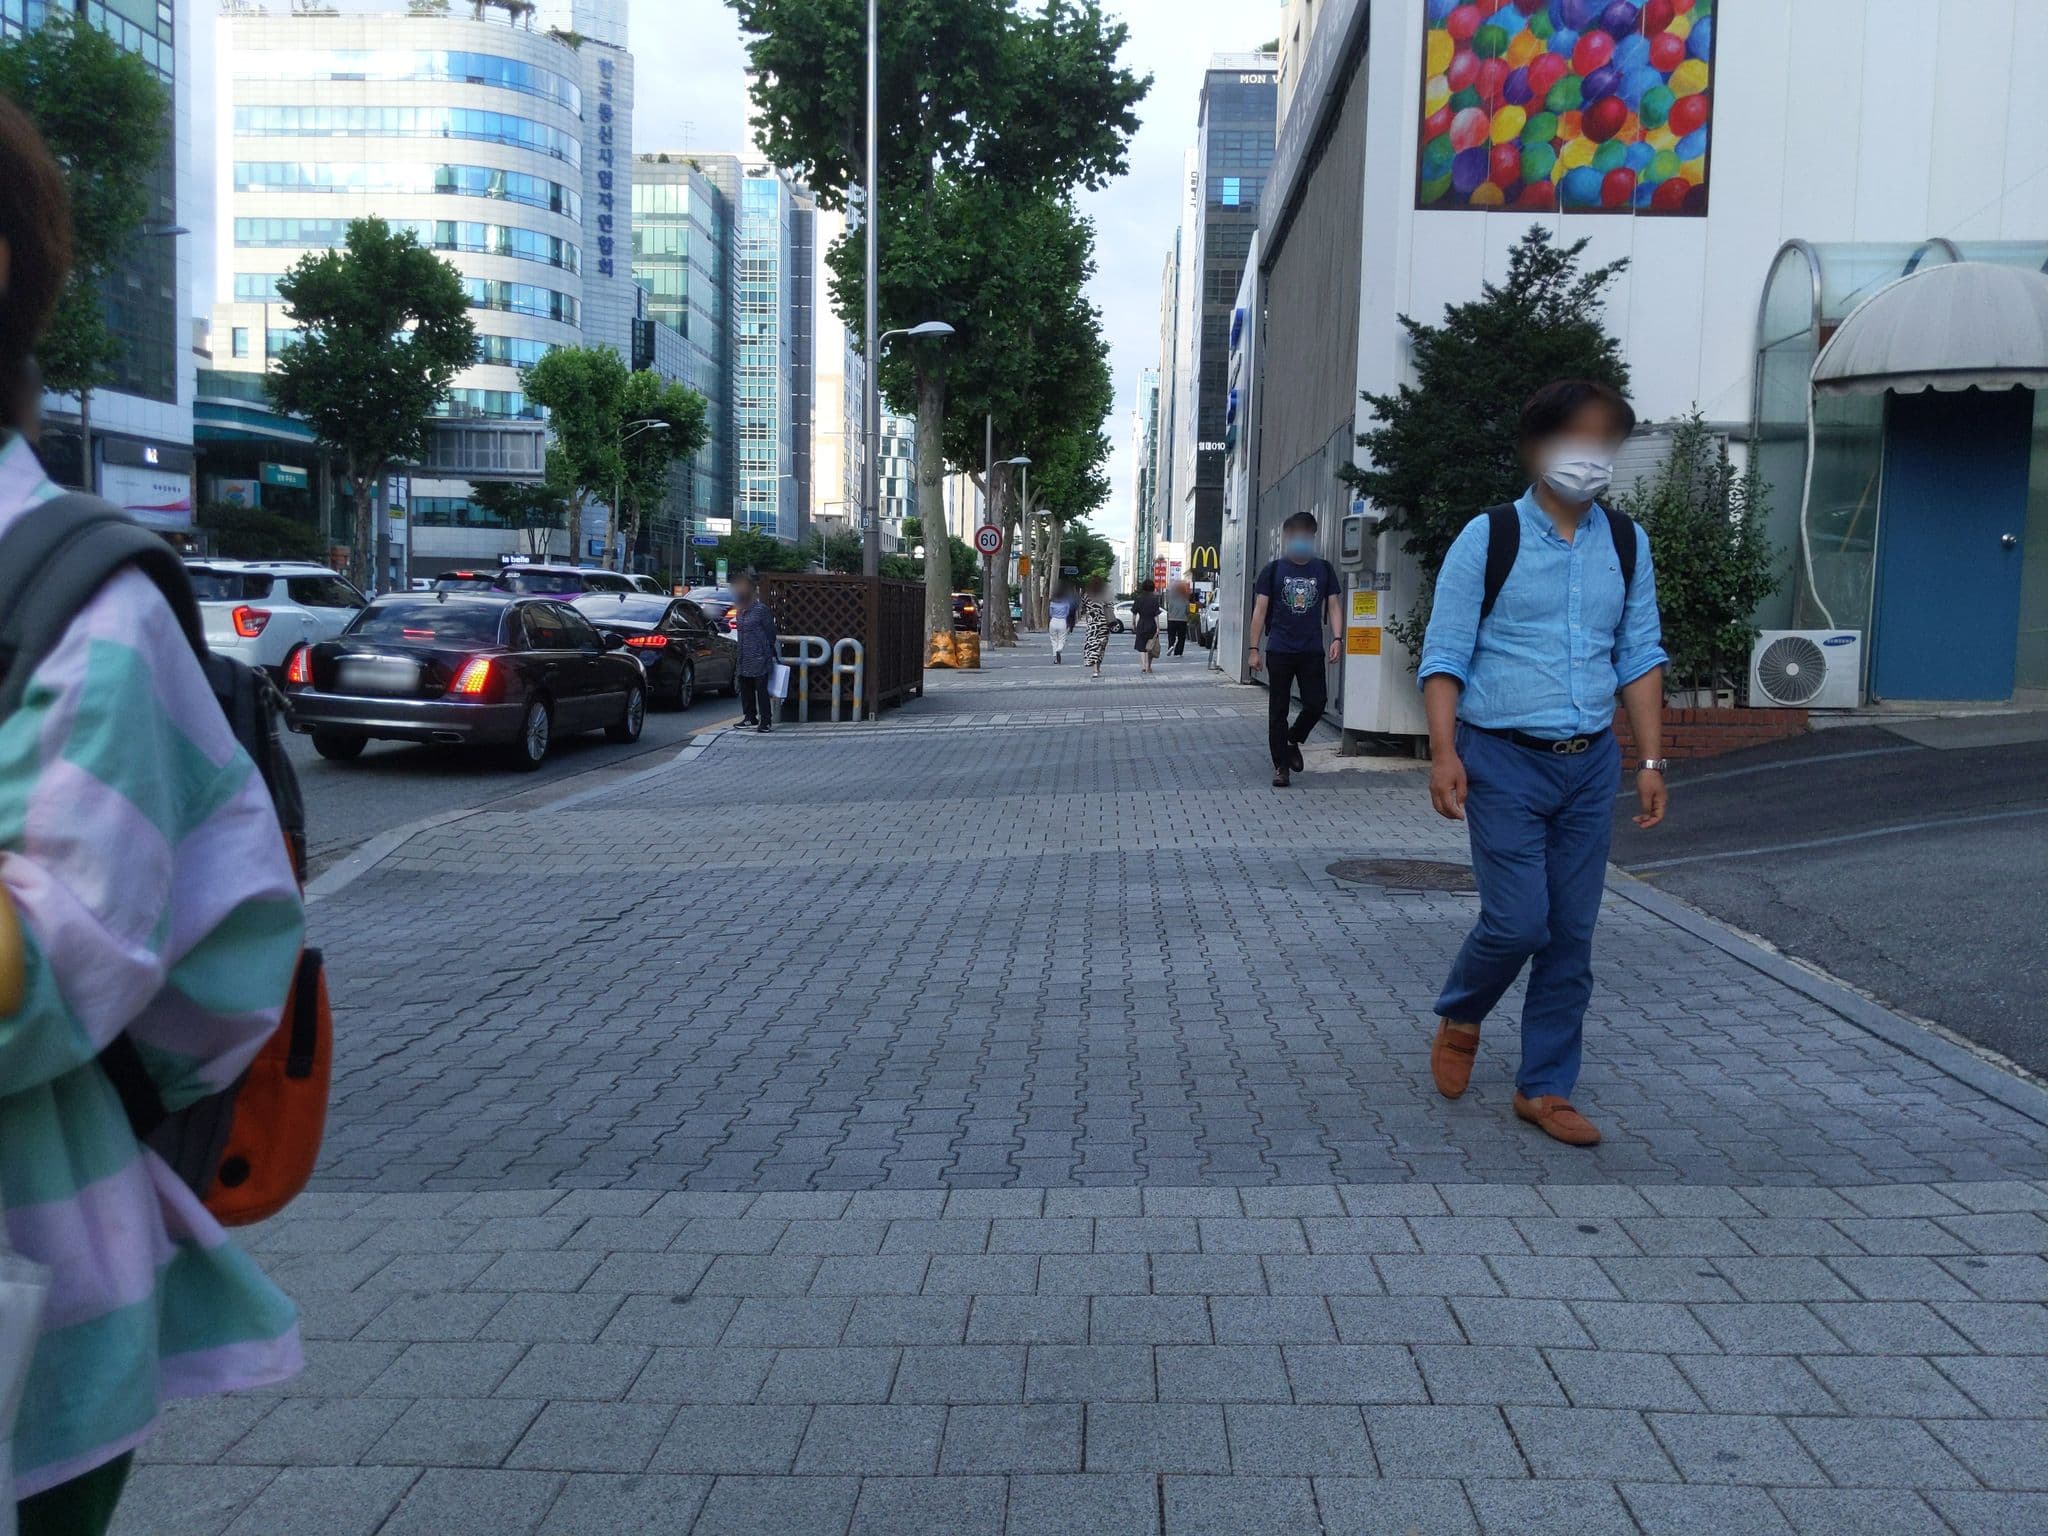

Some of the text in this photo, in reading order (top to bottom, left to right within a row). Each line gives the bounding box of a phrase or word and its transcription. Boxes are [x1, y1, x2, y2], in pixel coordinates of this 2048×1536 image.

[1240, 74, 1266, 84] MON
[598, 57, 615, 279] 한국통신사업자연합회
[981, 533, 997, 547] 60
[502, 555, 530, 563] la belle
